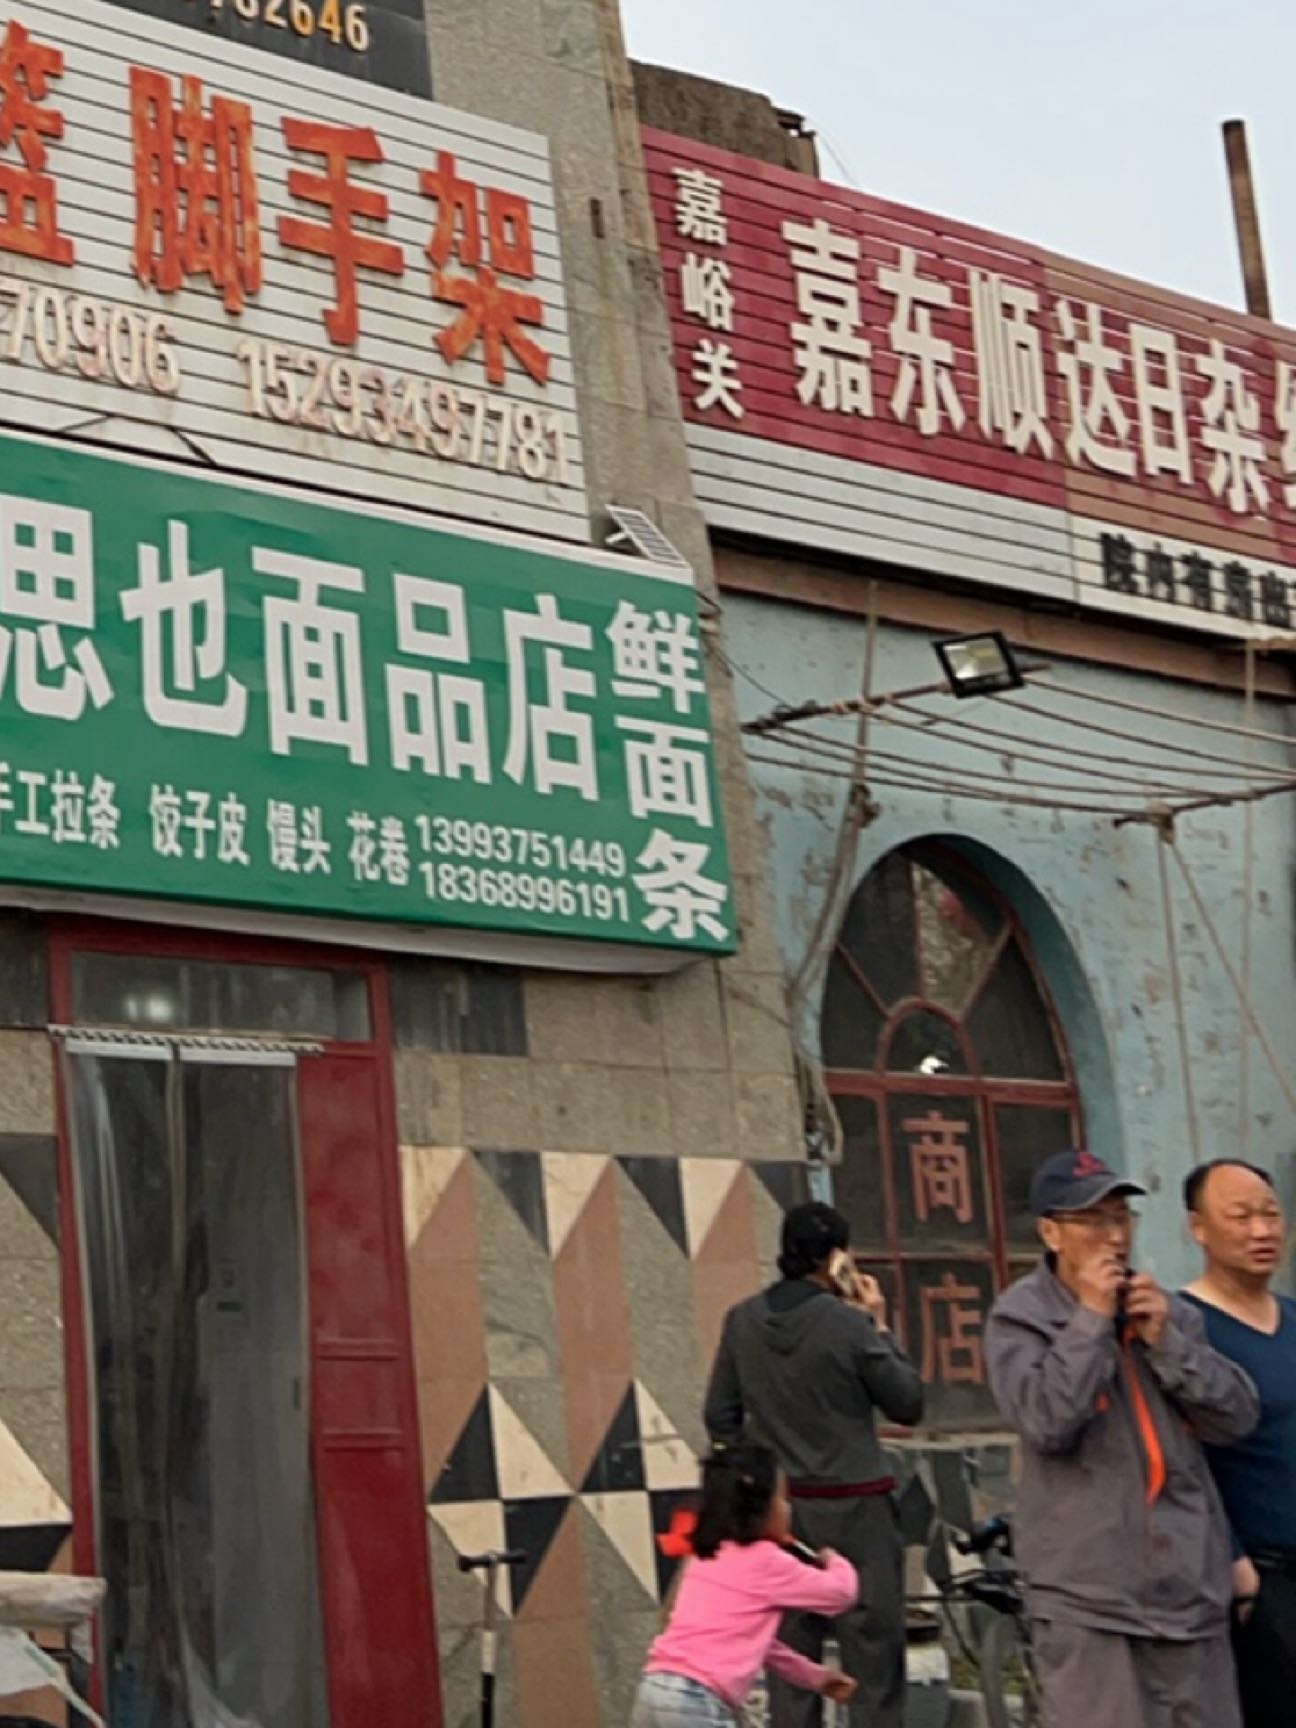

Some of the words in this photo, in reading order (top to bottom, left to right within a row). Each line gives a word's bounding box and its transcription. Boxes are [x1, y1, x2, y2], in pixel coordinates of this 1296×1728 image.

[128, 65, 551, 386] 脚手架
[671, 167, 745, 419] 嘉峪关
[236, 335, 569, 486] 15293497781
[149, 784, 250, 866] 饺子皮
[266, 798, 332, 875] 馒头
[345, 810, 409, 886] 花卷
[414, 814, 627, 879] 13993751449
[604, 599, 729, 943] 鲜面条
[418, 861, 629, 923] 18368996191
[902, 1110, 983, 1384] 商店
